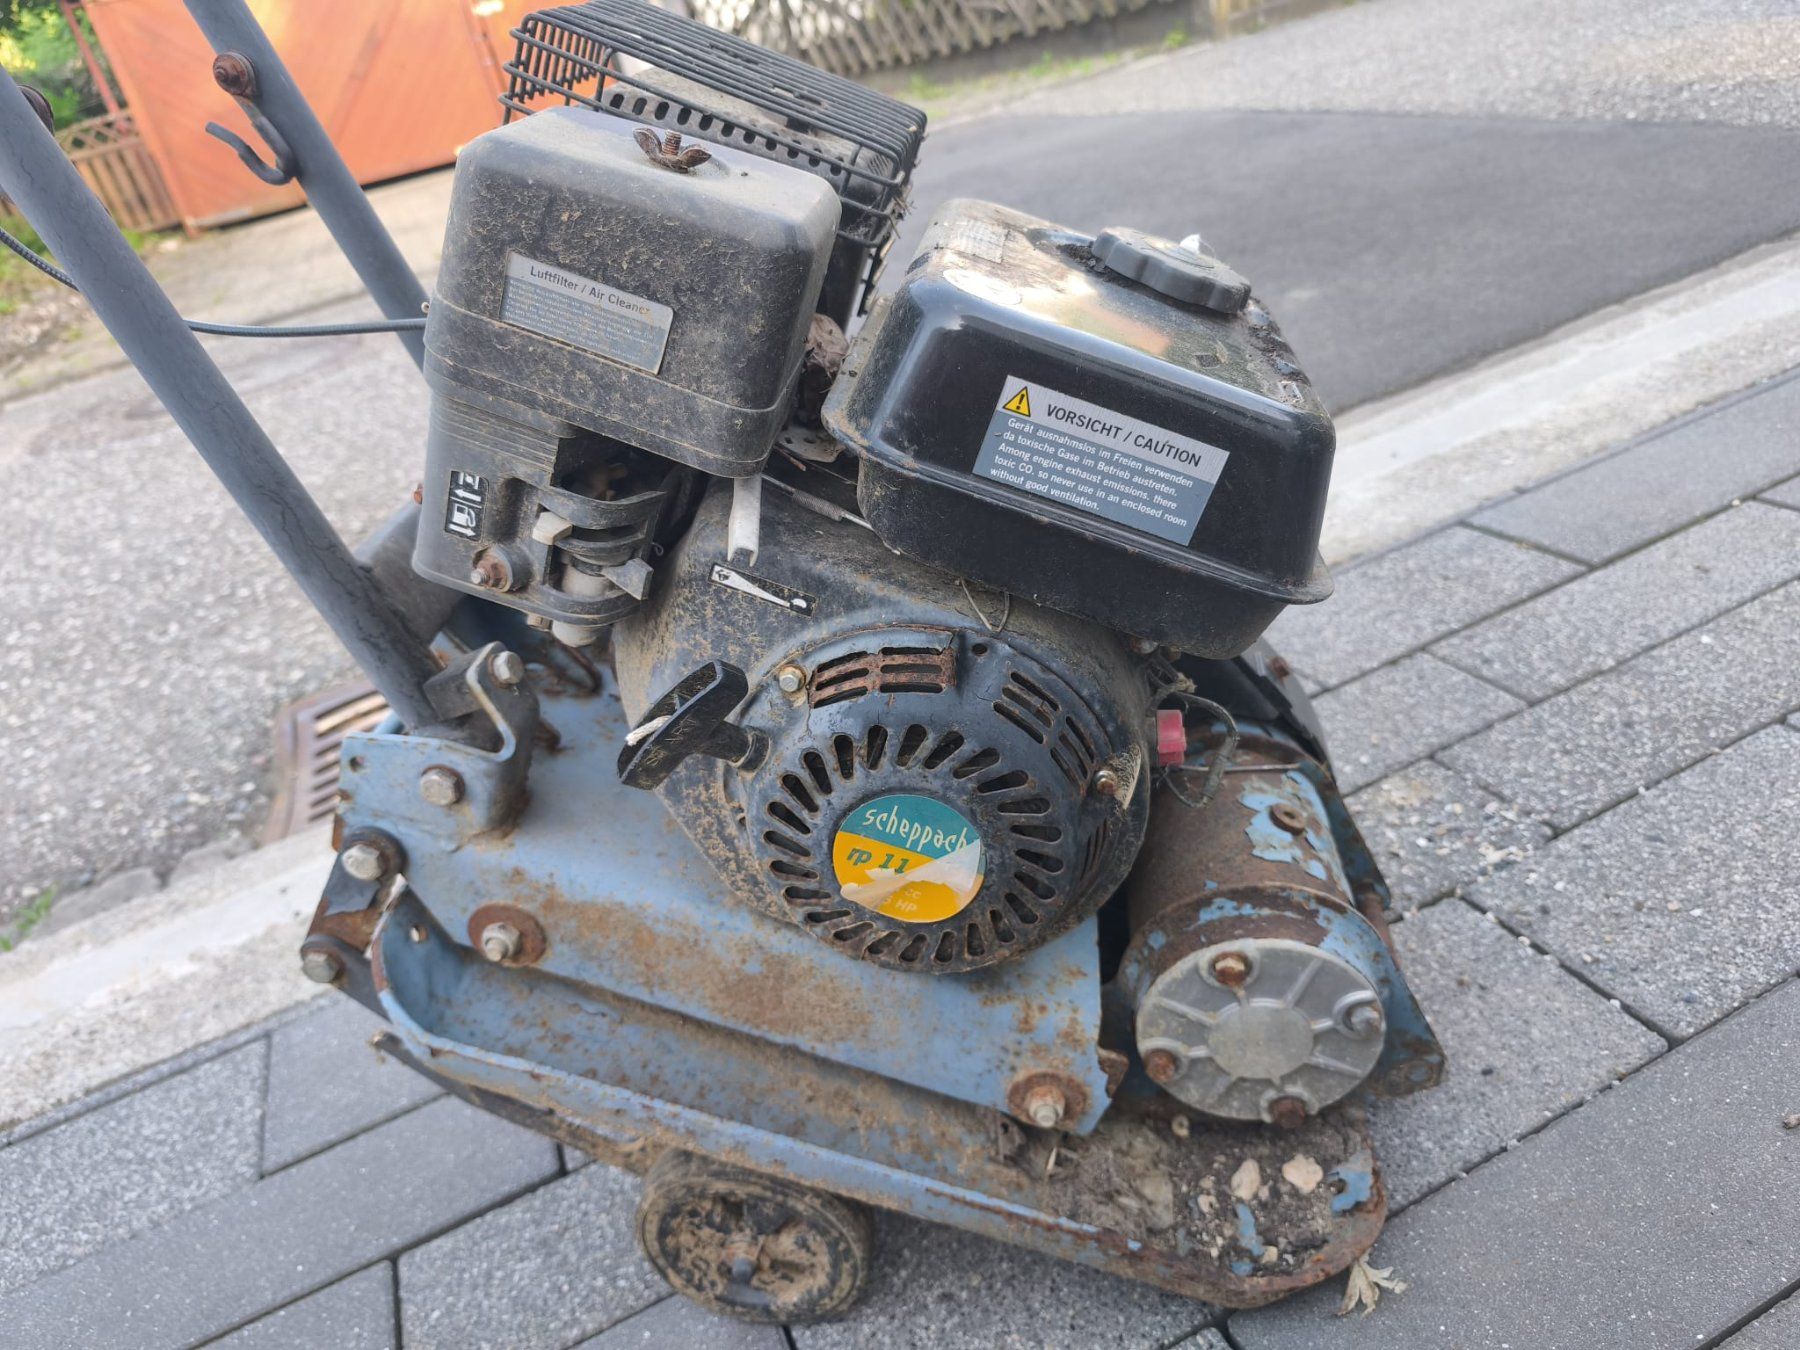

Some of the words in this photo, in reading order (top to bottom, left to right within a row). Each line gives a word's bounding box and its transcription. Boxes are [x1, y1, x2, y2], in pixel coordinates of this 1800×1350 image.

[530, 266, 580, 292] Luftfilter
[589, 287, 605, 300] Air
[1003, 430, 1014, 441] da
[1017, 434, 1055, 454] toxische
[1057, 447, 1080, 462] Gase
[1081, 455, 1094, 467] im
[1096, 461, 1130, 479] Betrieb
[1131, 475, 1176, 496] austreten.
[1007, 417, 1033, 433] Gerät
[1036, 429, 1096, 454] ausnahmslos
[1098, 447, 1110, 459] im
[1112, 452, 1142, 469] Freien
[1144, 465, 1193, 487] verwenden
[1047, 404, 1123, 440] VORSICHT
[1134, 435, 1202, 468] CAUTION
[990, 468, 1024, 484] without
[1024, 479, 1049, 493] good
[1050, 488, 1099, 510] ventilation.
[994, 454, 1016, 468] toxic
[1037, 470, 1048, 479] so
[1050, 474, 1075, 487] never
[1077, 484, 1093, 494] use
[1095, 488, 1105, 498] in
[1107, 494, 1119, 503] an
[1121, 498, 1162, 517] enclosed
[1163, 513, 1186, 526] room
[997, 442, 1030, 461] Among
[1032, 455, 1063, 470] engine
[1065, 466, 1101, 483] exhaust
[1152, 494, 1176, 509] there
[862, 805, 968, 852] scheppach
[846, 848, 872, 866] rp
[895, 900, 918, 912] HP
